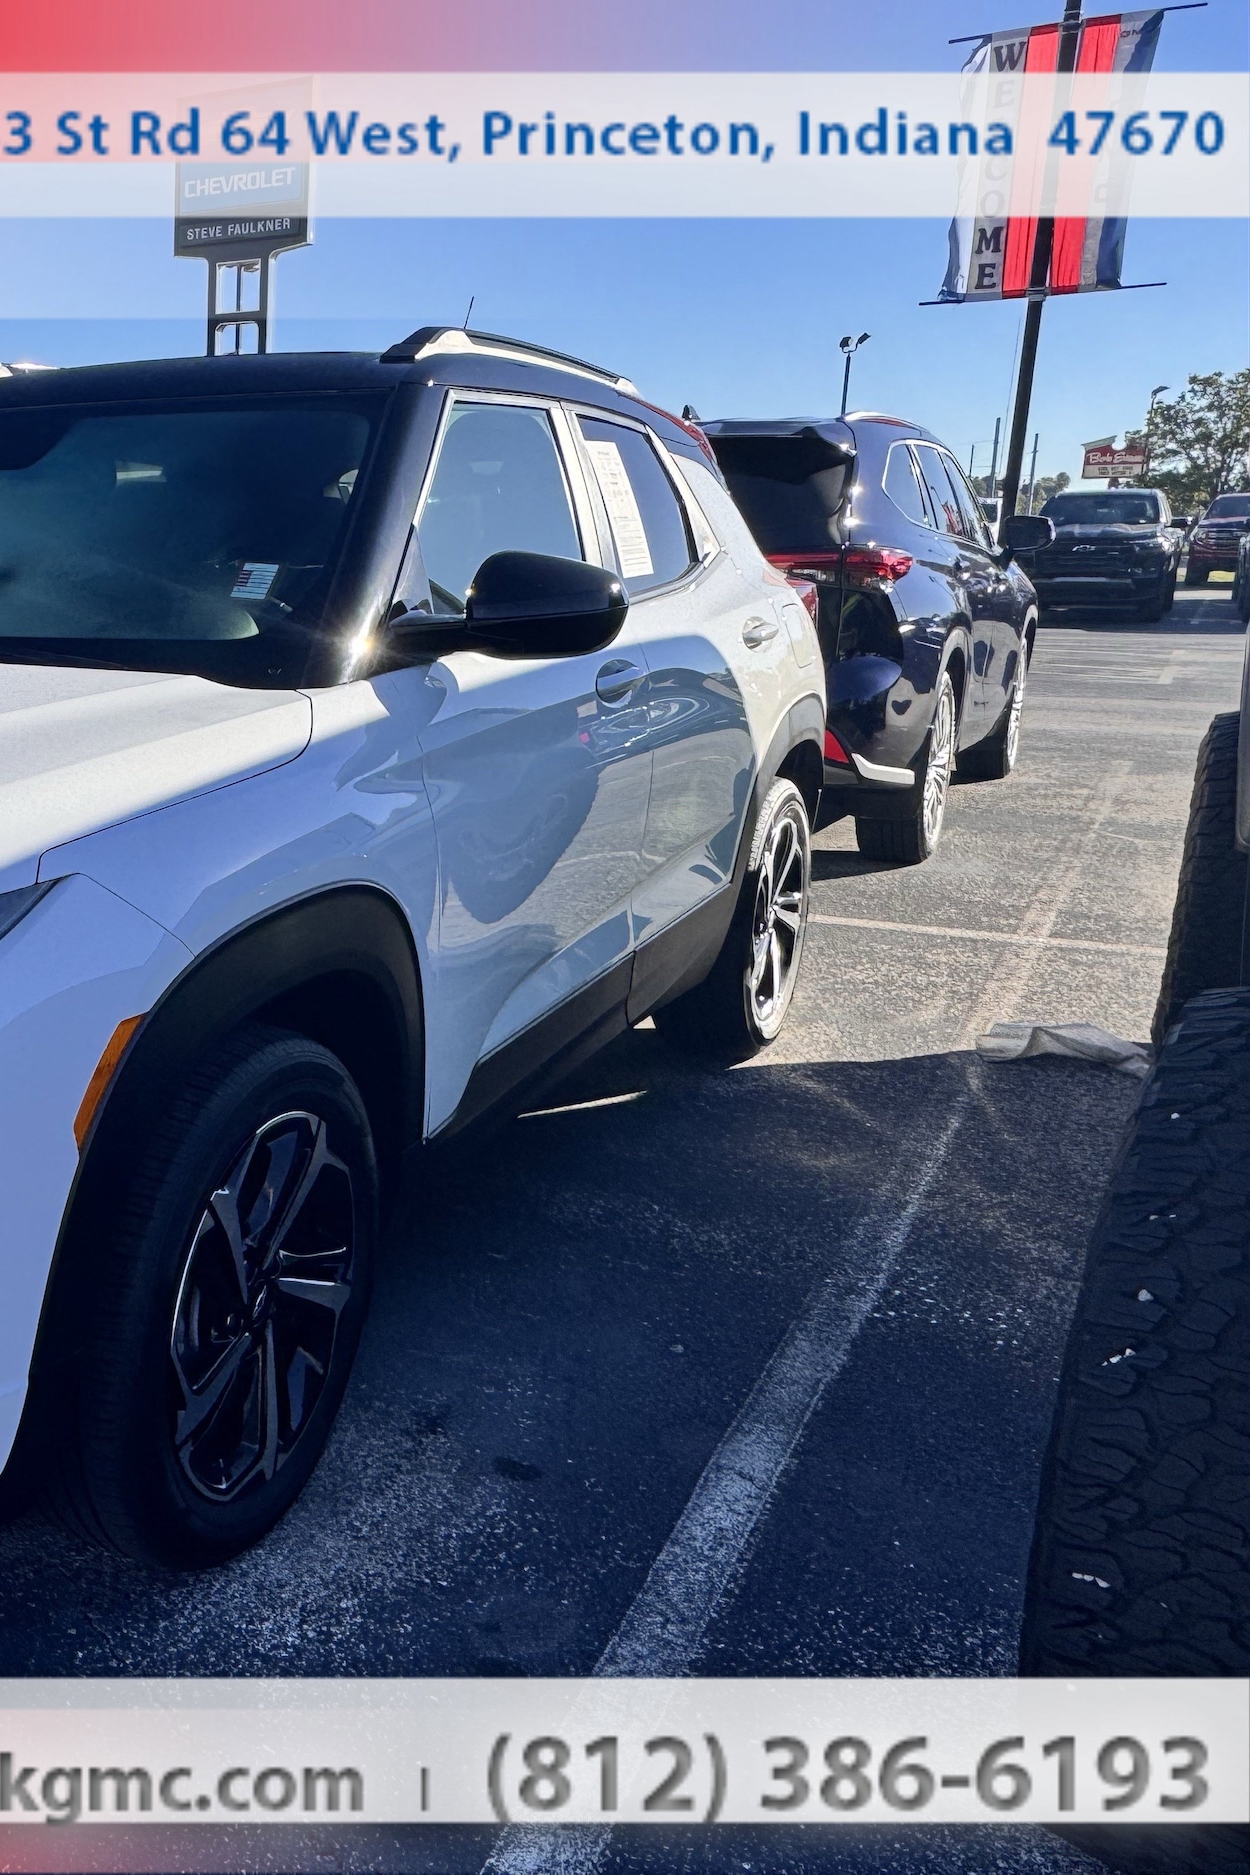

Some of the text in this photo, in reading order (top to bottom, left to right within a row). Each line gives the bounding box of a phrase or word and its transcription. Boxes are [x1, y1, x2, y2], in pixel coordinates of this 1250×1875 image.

[974, 41, 1028, 290] WECOME
[184, 167, 296, 198] CHEVROLET
[187, 217, 291, 241] STEVE FAULKNER
